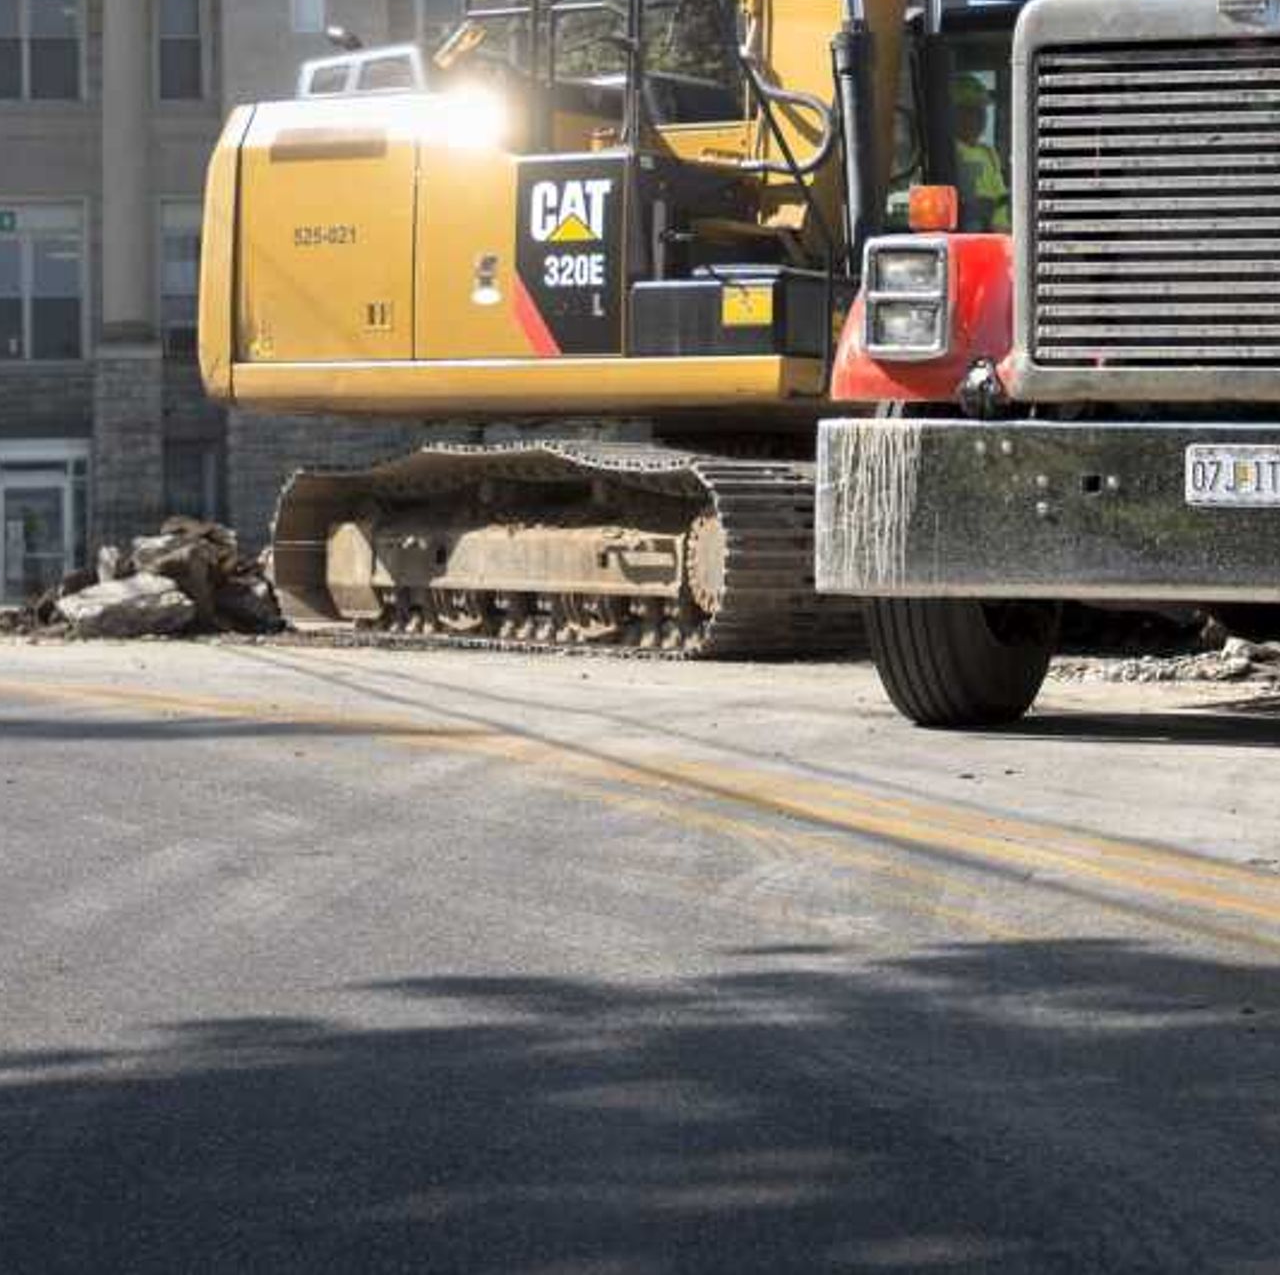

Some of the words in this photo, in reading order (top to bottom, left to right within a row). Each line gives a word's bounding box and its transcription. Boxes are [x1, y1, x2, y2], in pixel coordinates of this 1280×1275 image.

[530, 179, 612, 242] CAT
[544, 253, 604, 286] 320E
[592, 293, 604, 316] L
